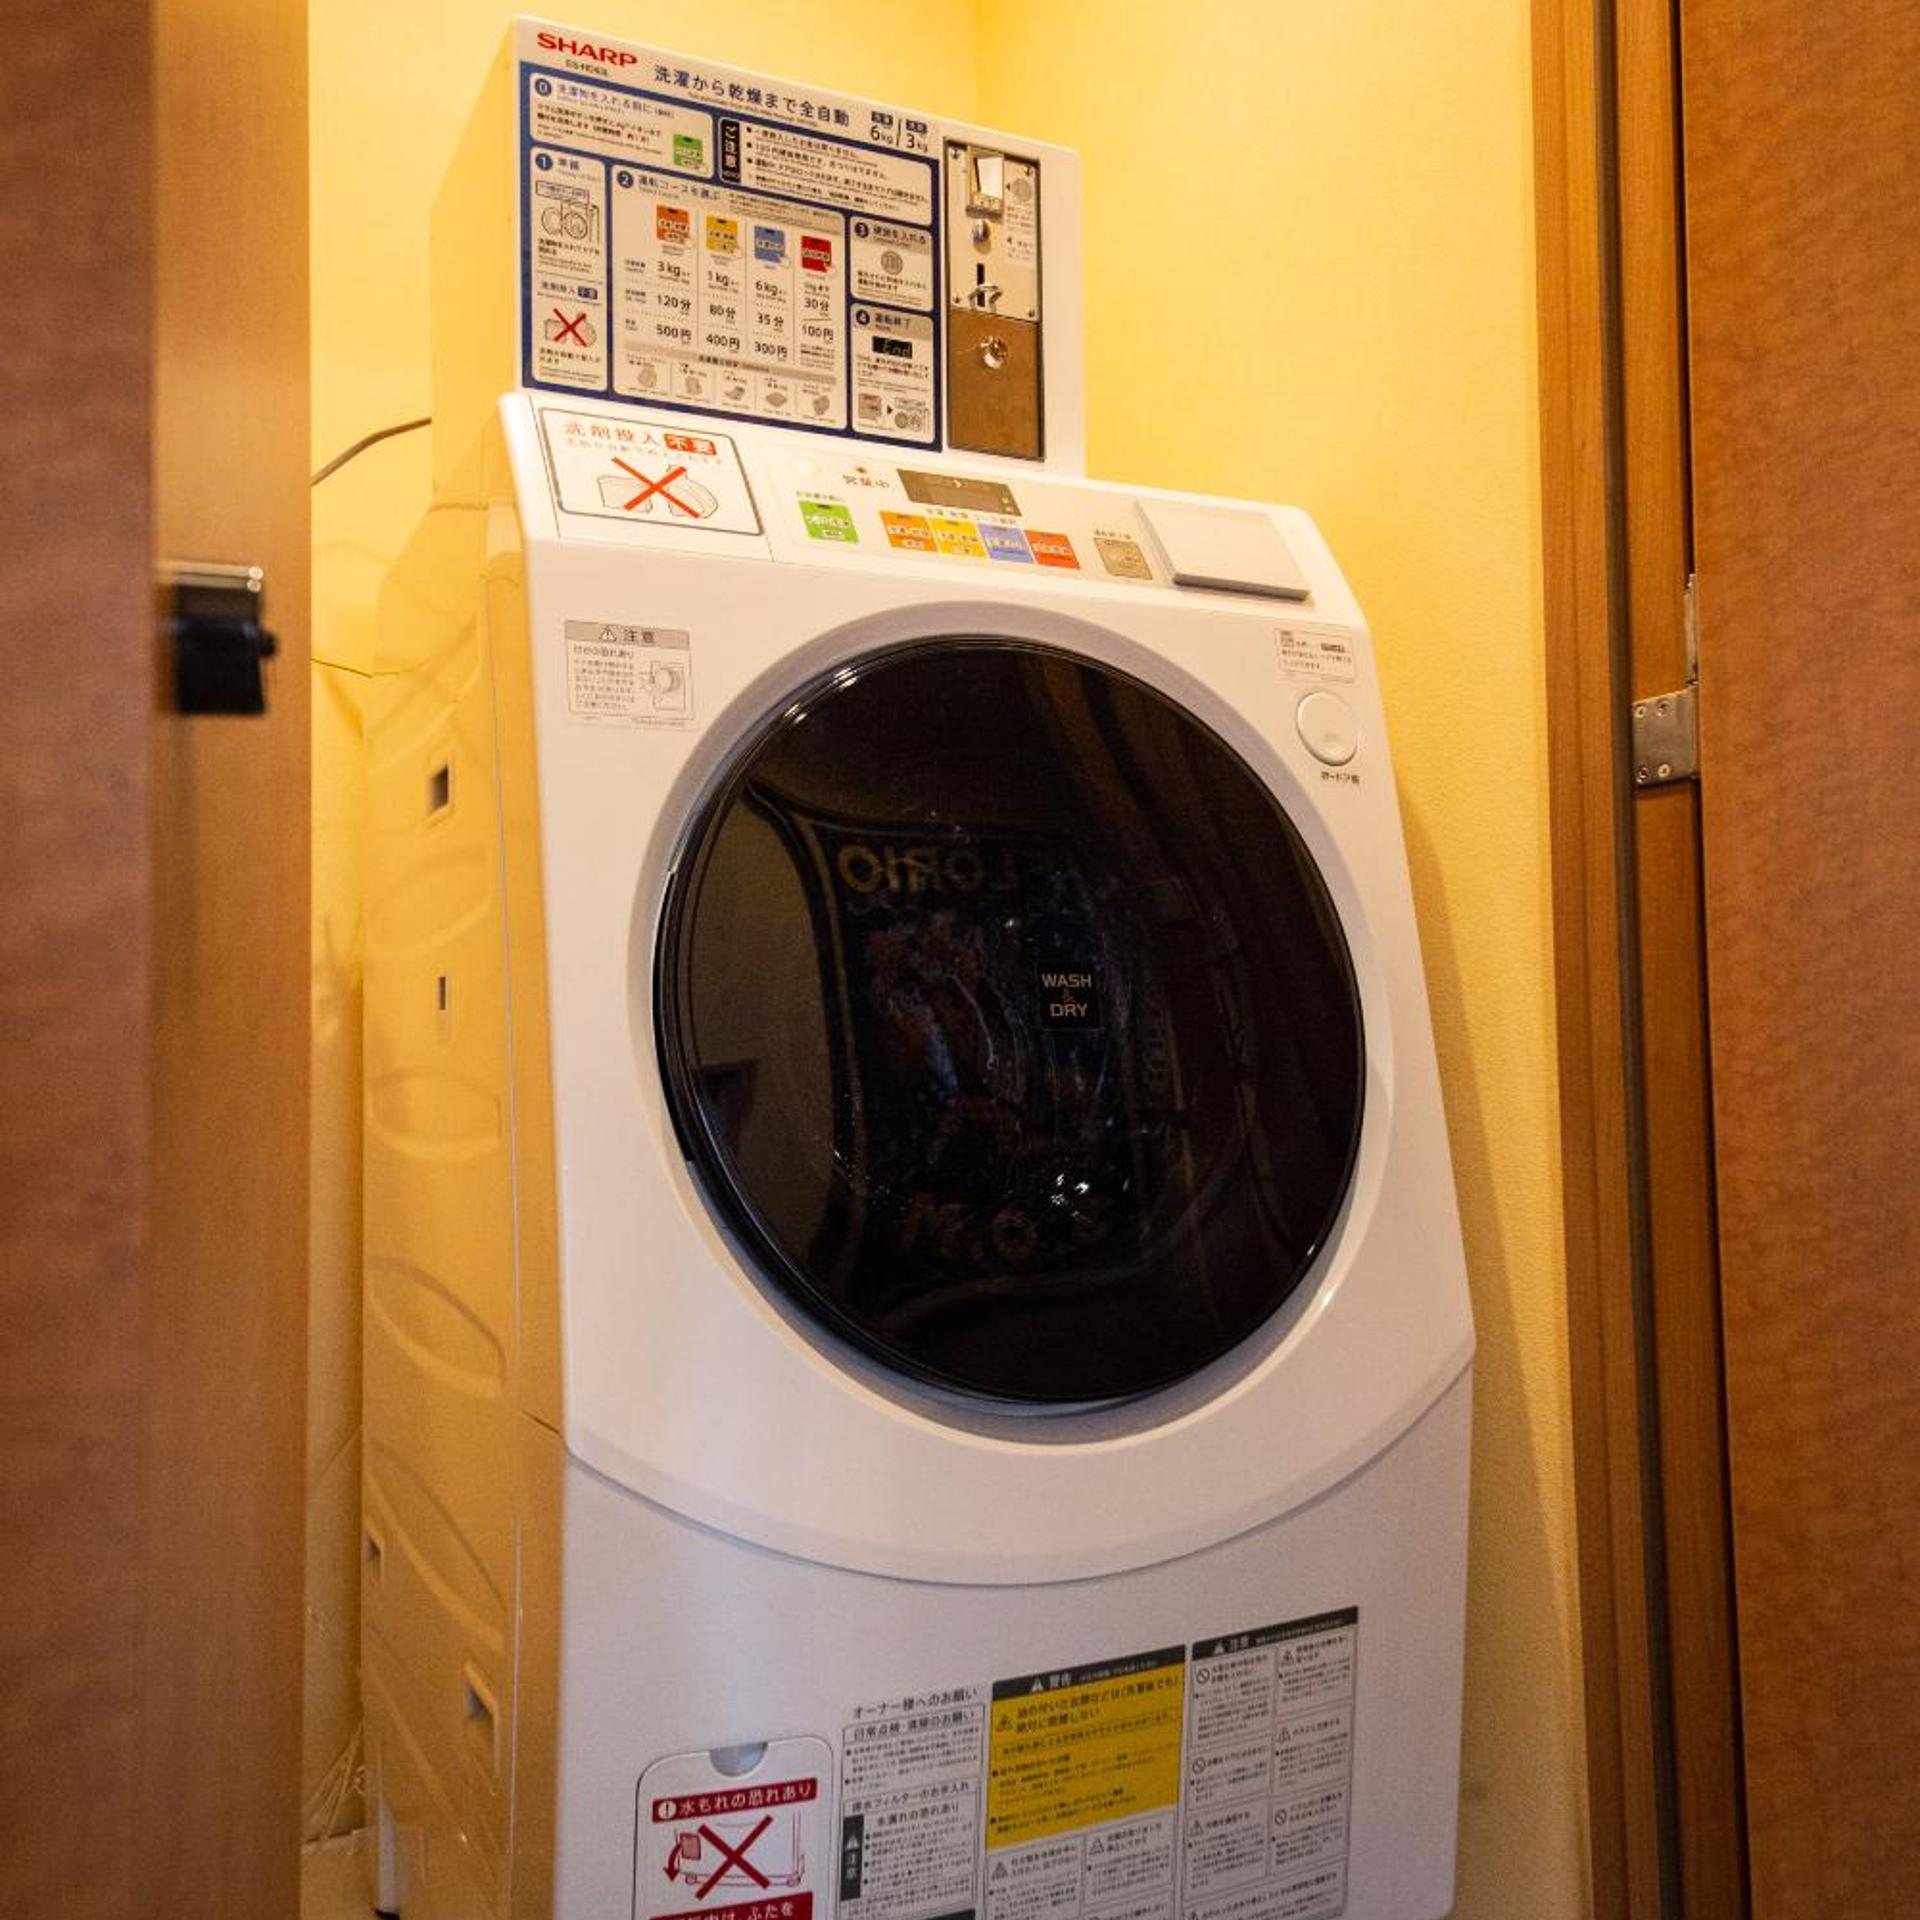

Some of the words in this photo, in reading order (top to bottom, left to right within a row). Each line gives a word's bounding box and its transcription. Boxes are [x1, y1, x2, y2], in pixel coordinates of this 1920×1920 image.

[537, 32, 638, 67] SHARP
[653, 63, 850, 128] 洗濯から乾燥まで全自動
[657, 294, 692, 311] 120分
[803, 298, 831, 313] 30分
[708, 304, 736, 321] 80分
[757, 312, 784, 330] 35分
[656, 323, 692, 342] 500円
[801, 325, 834, 341] 100円
[705, 335, 741, 352] 400円
[754, 341, 788, 359] 300円
[564, 420, 661, 447] 洗剤投入
[1041, 972, 1093, 989] WASH
[1049, 1002, 1089, 1019] DRY
[855, 1687, 978, 1719] オーナー様へのお願い
[678, 1783, 813, 1817] 水もれの恐れあり
[852, 1781, 970, 1813] 排水フィルターのお手入れ
[877, 1801, 960, 1826] 水漏れの恐れあり
